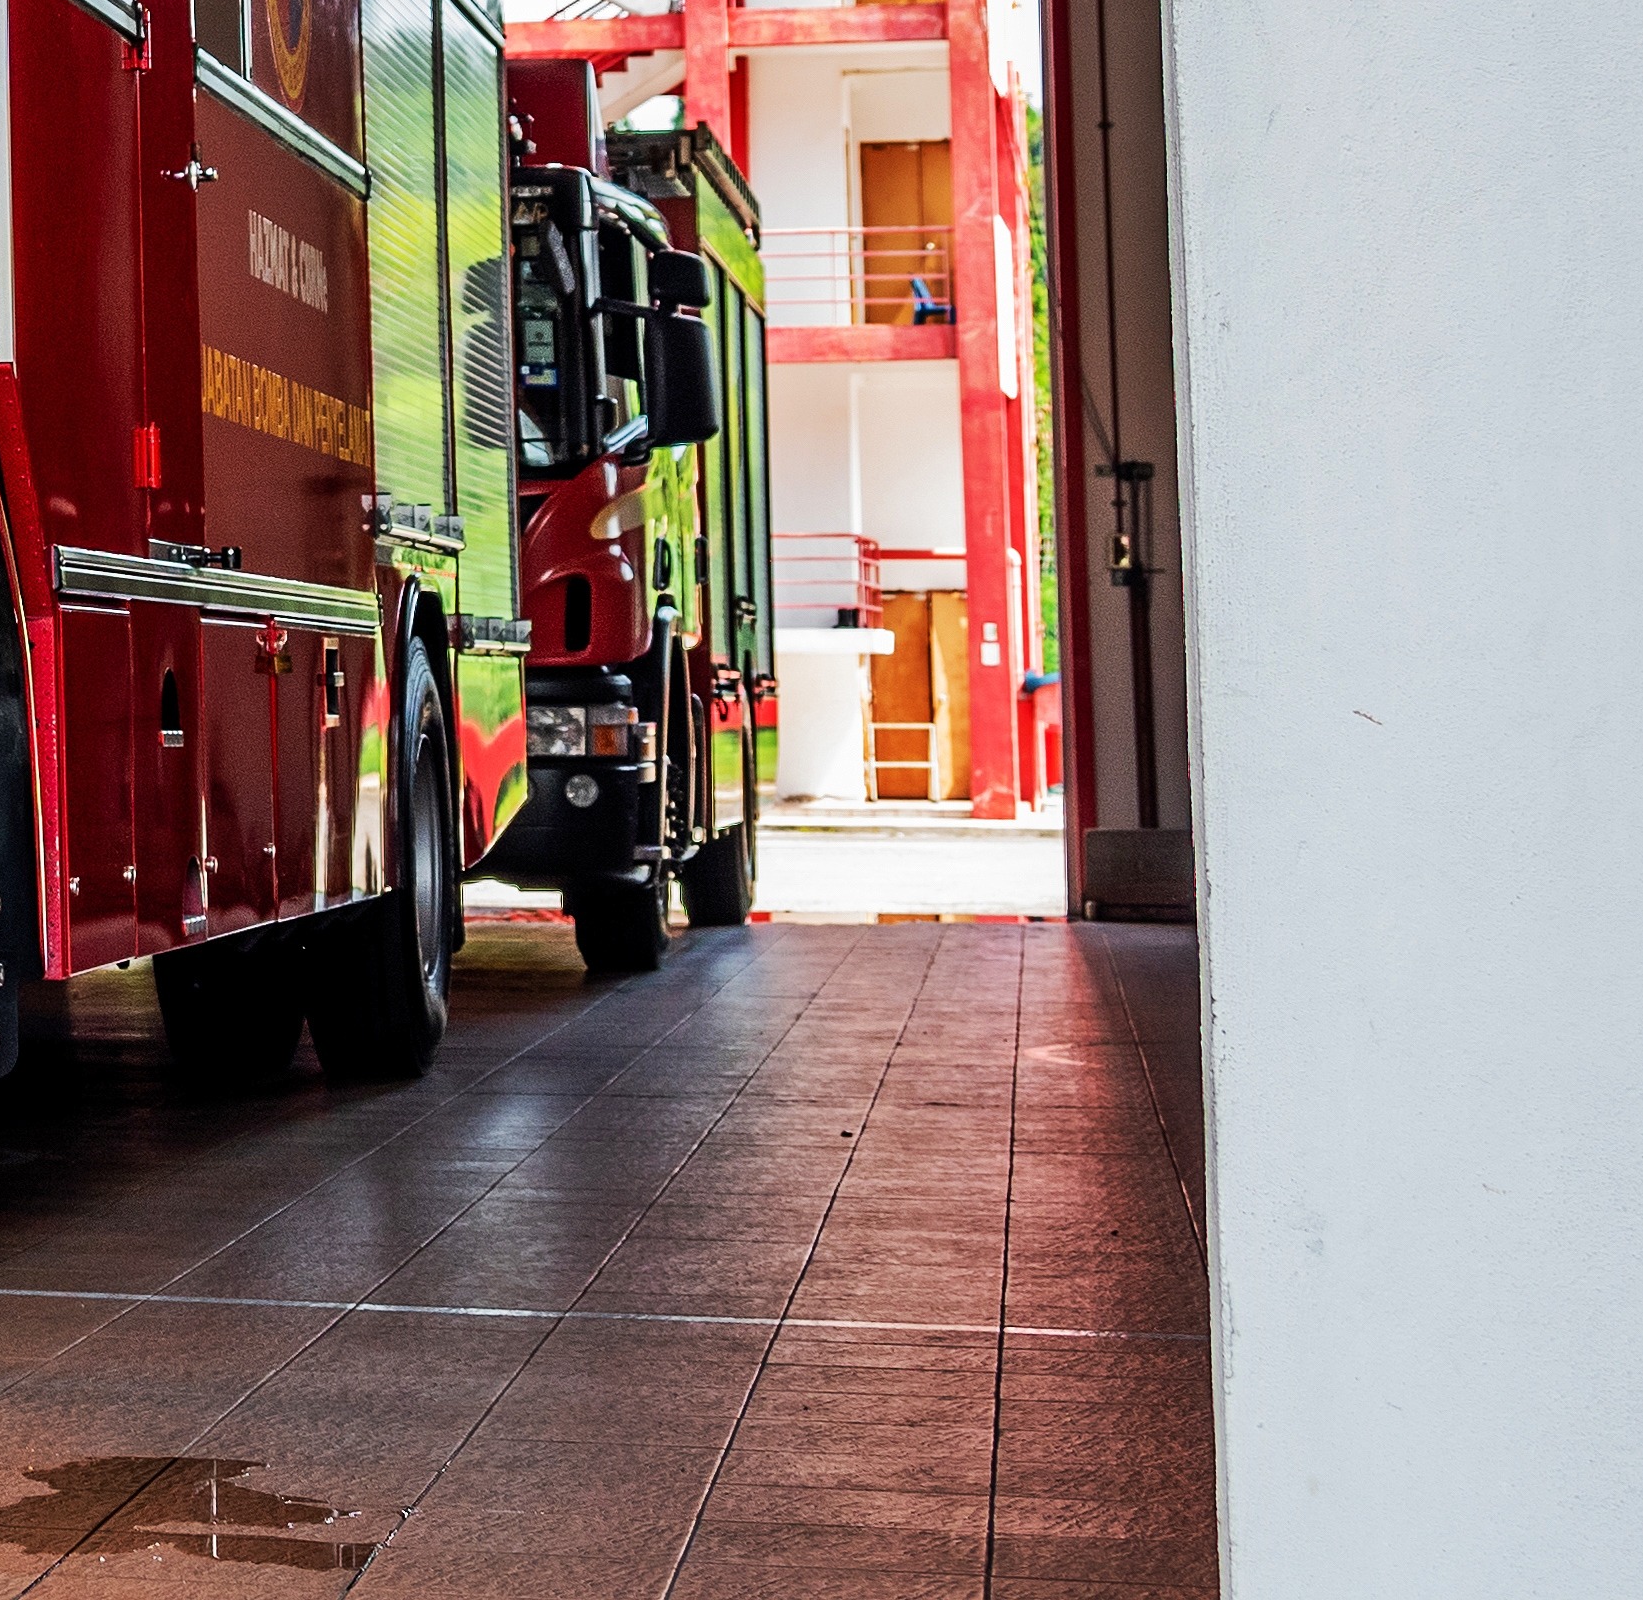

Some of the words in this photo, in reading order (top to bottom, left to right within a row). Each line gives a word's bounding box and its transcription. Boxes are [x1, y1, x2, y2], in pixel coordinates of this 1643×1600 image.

[249, 209, 290, 294] HAZMAT
[201, 343, 252, 427] JABATAN
[253, 364, 292, 441] BOMBA
